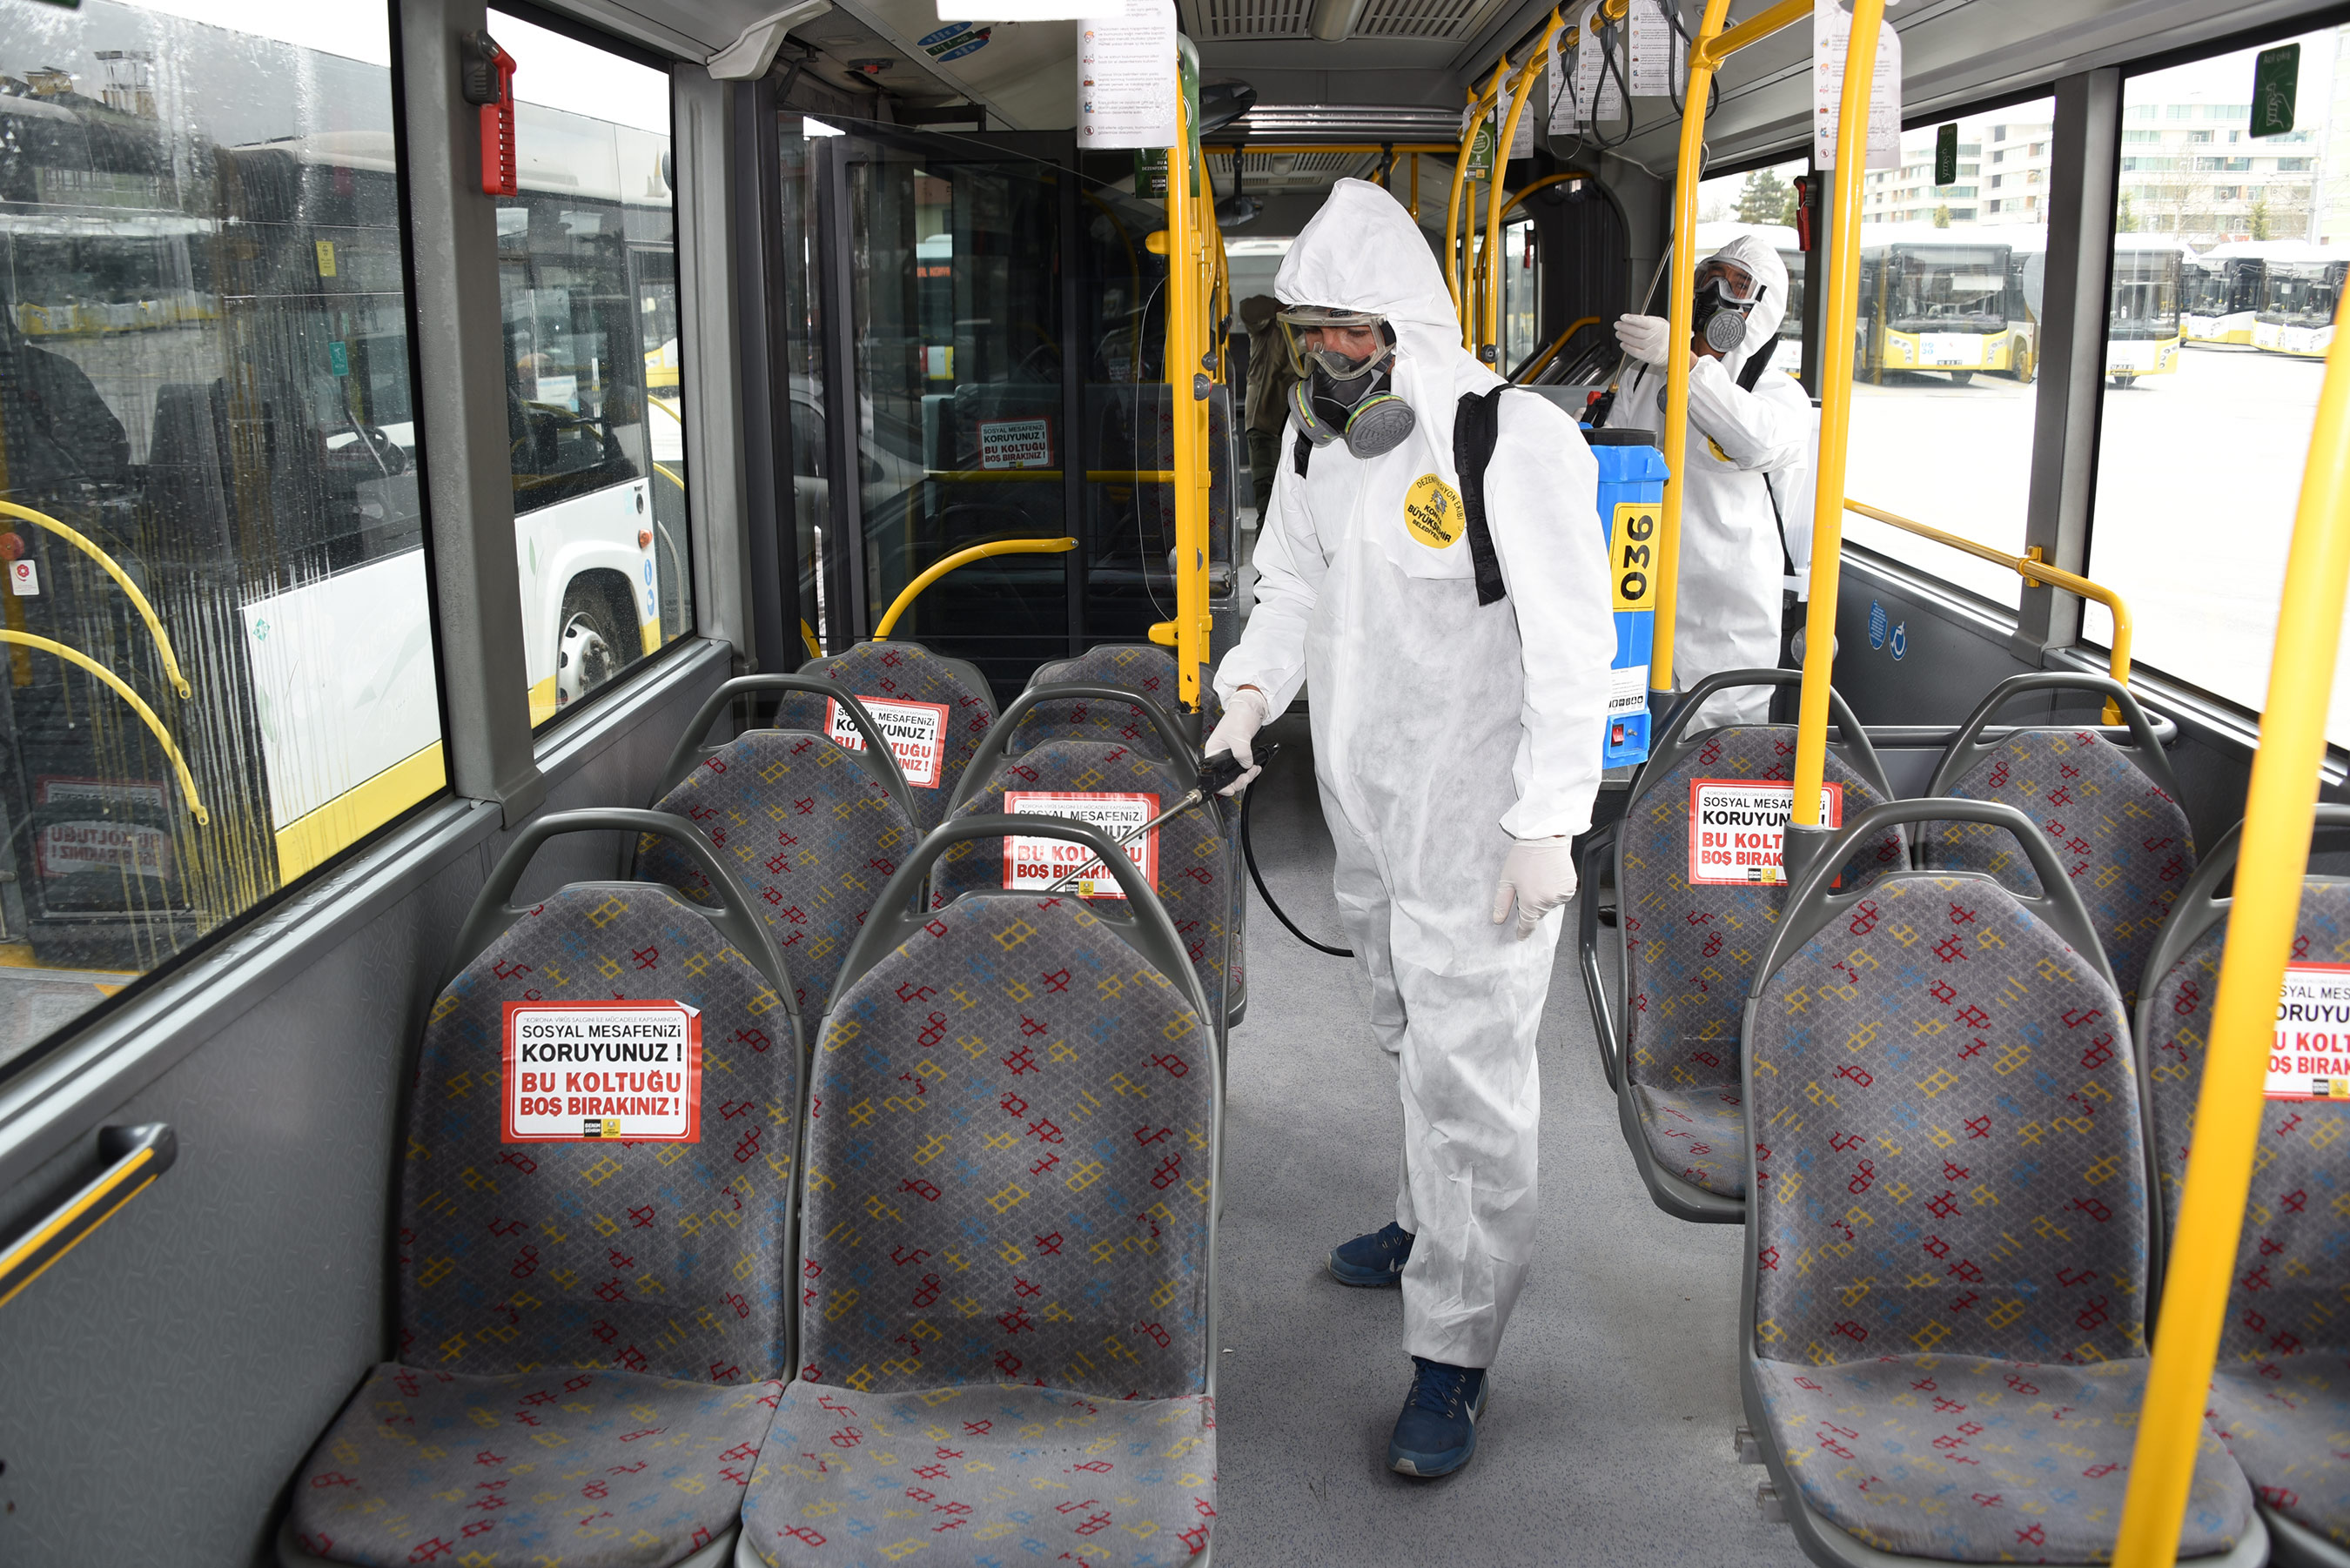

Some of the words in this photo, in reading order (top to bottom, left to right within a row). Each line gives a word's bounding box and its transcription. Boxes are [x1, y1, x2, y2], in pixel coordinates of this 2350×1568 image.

[984, 432, 1040, 443] KORUYUNUZ
[984, 446, 998, 454] BU
[1003, 452, 1042, 462] BIRAKINIZ
[1621, 514, 1654, 600] 036
[836, 718, 925, 740] KOYUNUZ
[1703, 797, 1750, 808] SOSYAL
[1703, 810, 1791, 827] KORUYUN
[1702, 832, 1727, 848] BU
[1735, 833, 1783, 849] KOLT
[1017, 846, 1044, 861] BU
[1052, 846, 1142, 862] KOLU
[1702, 850, 1732, 866] BOŞ
[1736, 851, 1783, 867] BIRAK
[1017, 864, 1049, 879] BOŞ
[1053, 864, 1141, 879] BIRAKIN
[2280, 985, 2315, 998] SYAL
[2275, 1002, 2350, 1023] ORUYU
[522, 1025, 584, 1038] SOSYAL
[2271, 1030, 2286, 1050] U
[2296, 1032, 2350, 1054] KOLT
[522, 1043, 668, 1062] KORUYUNUZ
[2267, 1055, 2292, 1075] OŞ
[2297, 1056, 2350, 1075] BIRAK
[521, 1072, 556, 1093] BU
[566, 1069, 681, 1093] KOLTUĞU
[520, 1097, 563, 1117] BOŞ
[567, 1097, 669, 1116] BIRAKINIZ
